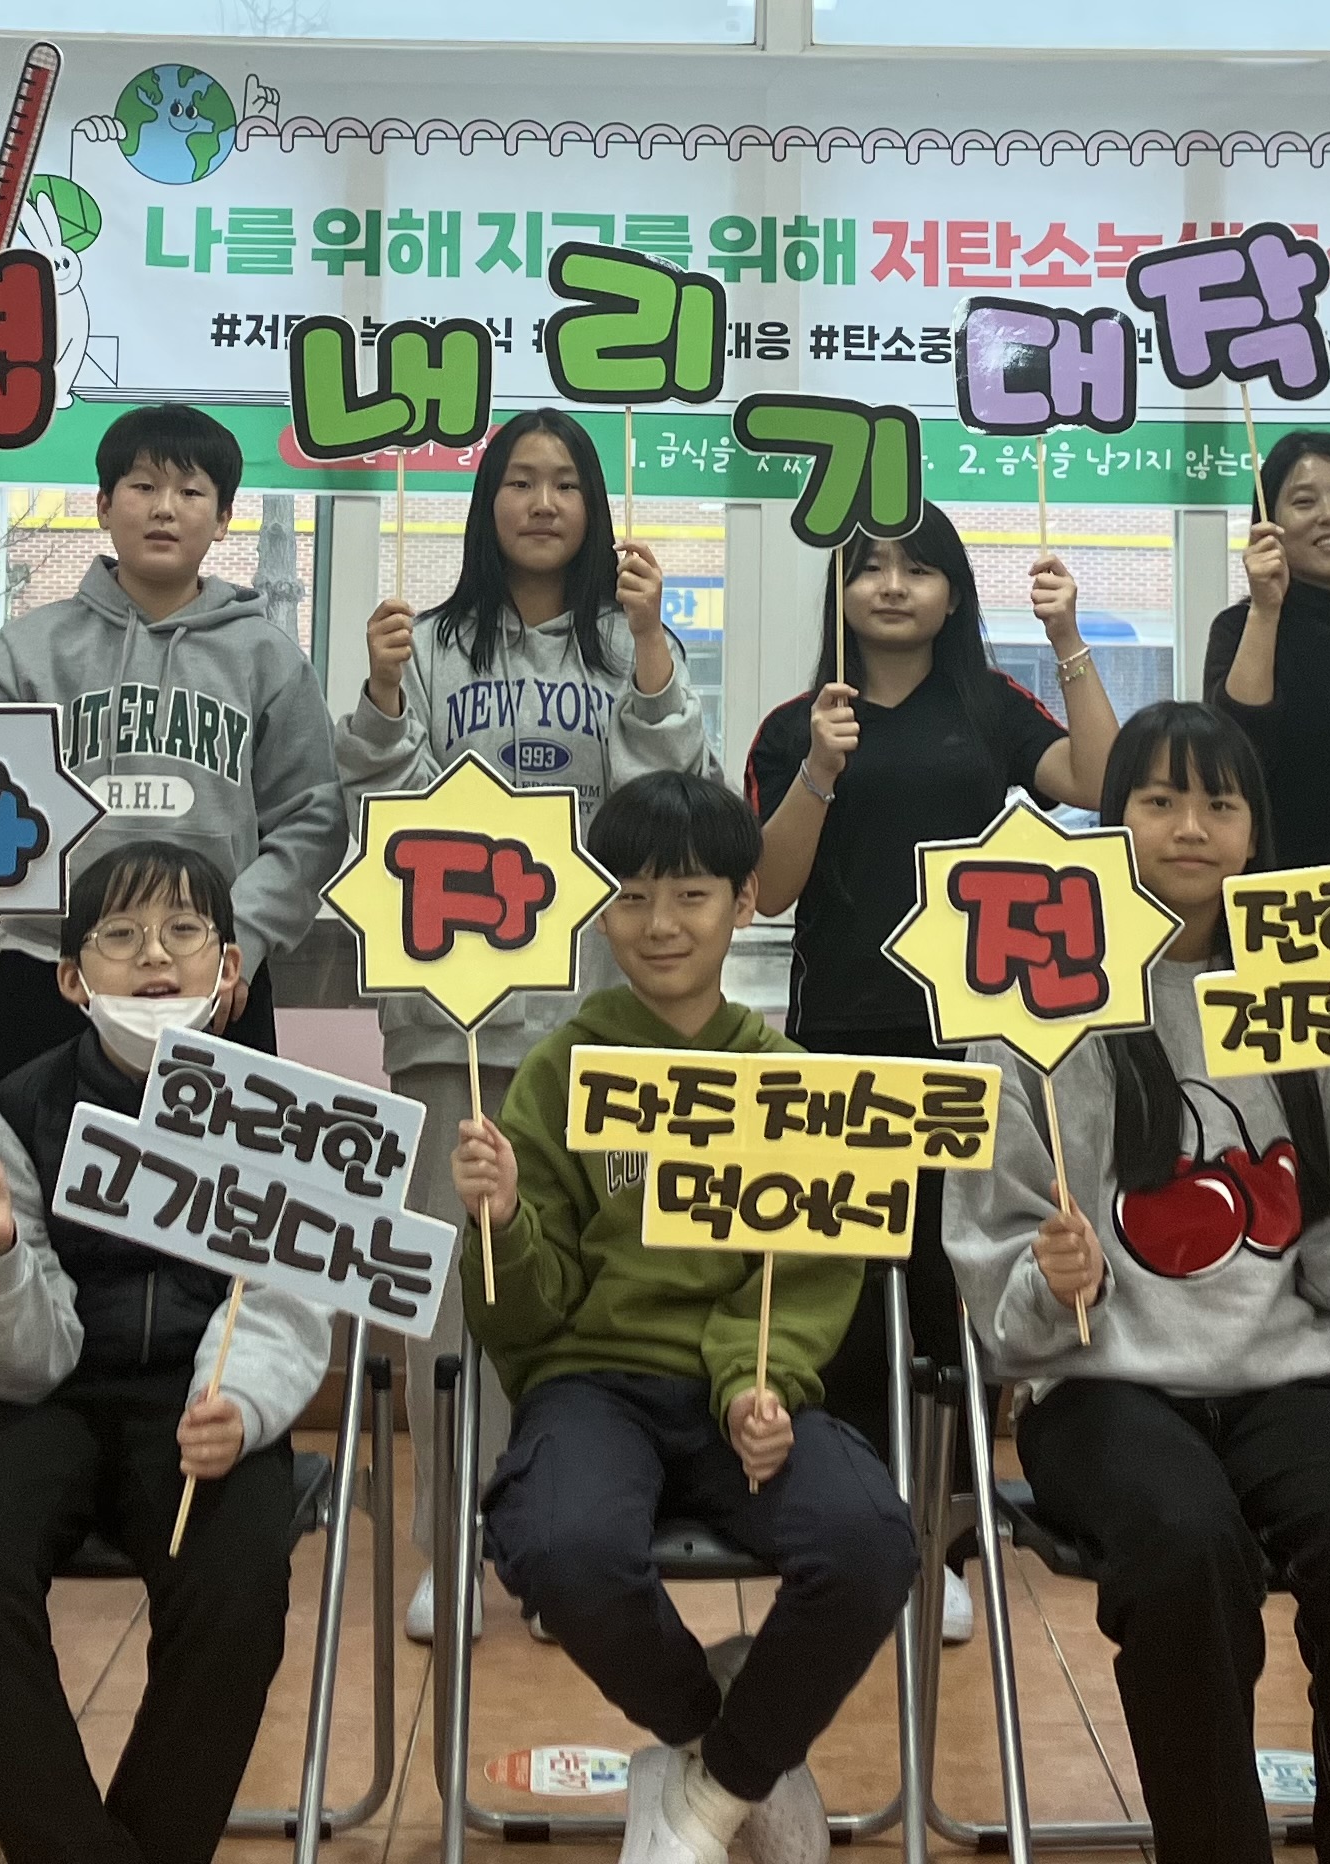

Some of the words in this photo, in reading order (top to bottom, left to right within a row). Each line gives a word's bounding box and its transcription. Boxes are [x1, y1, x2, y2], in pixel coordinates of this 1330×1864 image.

[145, 206, 297, 275] 나를
[311, 208, 462, 278] 위해
[707, 214, 857, 286] 위해
[810, 324, 952, 364] #탄소중
[657, 432, 736, 474] 급식을
[958, 444, 986, 475] 2.
[995, 441, 1076, 479] 음식을
[1086, 444, 1171, 476] 남기지
[62, 682, 251, 787] ITERARY
[446, 678, 526, 751] NEW
[517, 745, 556, 767] 993
[385, 830, 554, 960] 자
[948, 862, 1105, 1019] 전
[155, 1044, 407, 1197] 화려한
[579, 1065, 737, 1147] 자주
[756, 1070, 990, 1158] 채소를
[65, 1123, 433, 1318] 고기보다는
[657, 1160, 912, 1241] 먹어서
